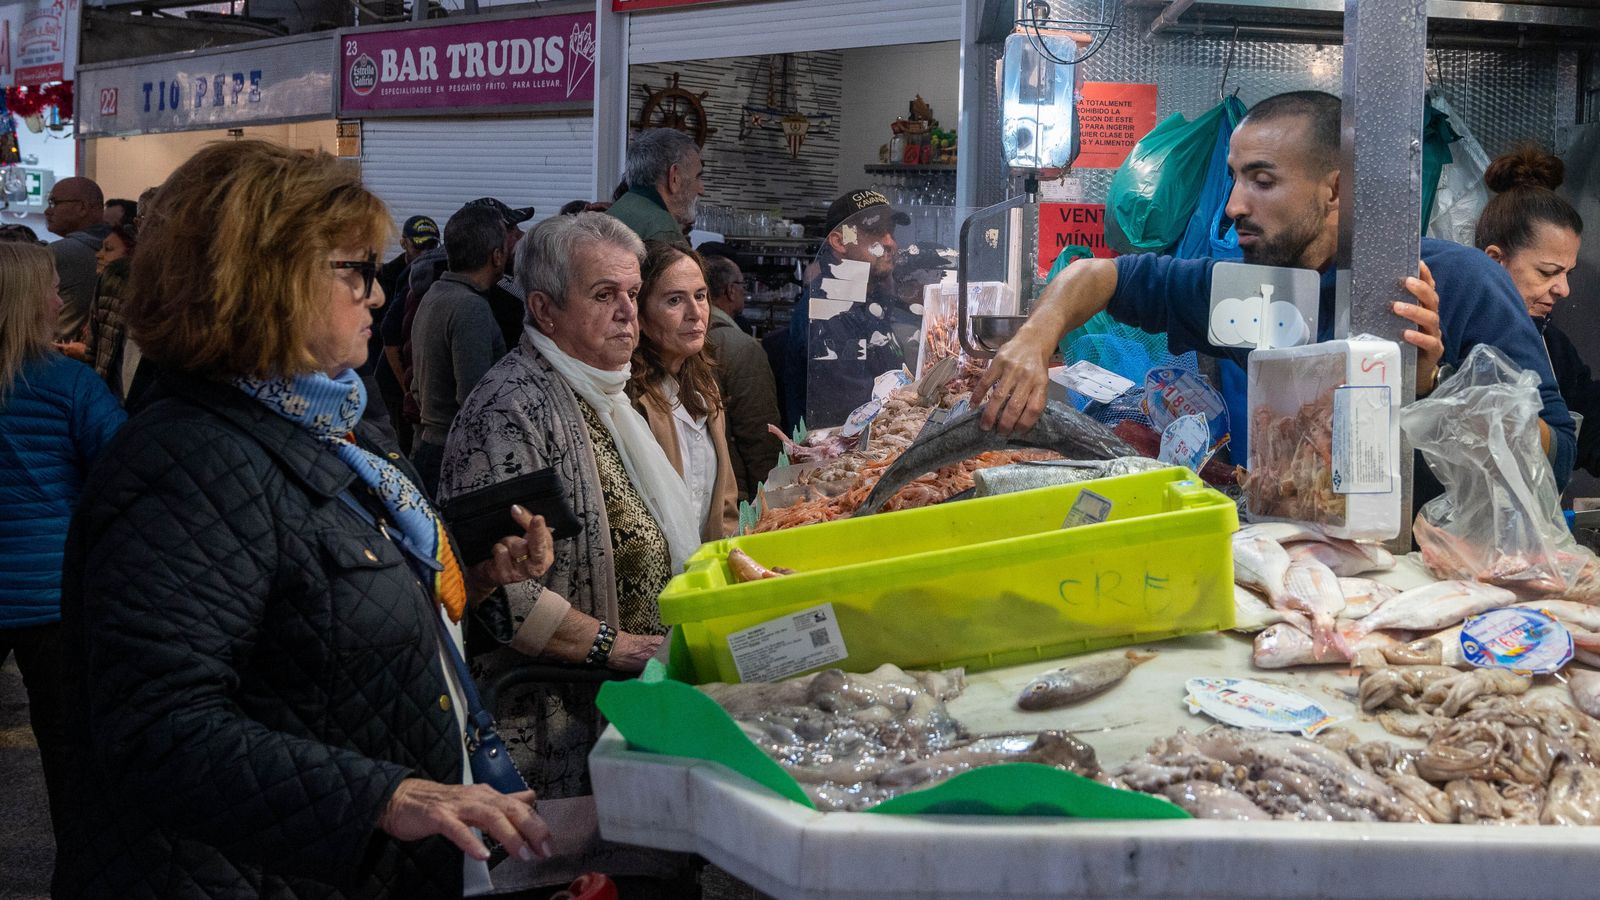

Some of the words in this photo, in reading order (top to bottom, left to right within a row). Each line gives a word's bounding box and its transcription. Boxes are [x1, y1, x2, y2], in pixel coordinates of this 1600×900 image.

[346, 40, 358, 56] 23
[381, 46, 439, 82] BAR
[446, 36, 565, 79] TRUDIS
[143, 79, 180, 112] TIO
[195, 70, 262, 108] PEPE
[381, 86, 432, 96] ESPECIALIDADES
[436, 85, 445, 93] EN
[512, 81, 531, 89] PARA
[102, 89, 116, 114] 22
[1086, 99, 1132, 107] TOTALMENTE
[1099, 131, 1123, 139] CLASE
[1094, 139, 1135, 147] ALIMENTOS
